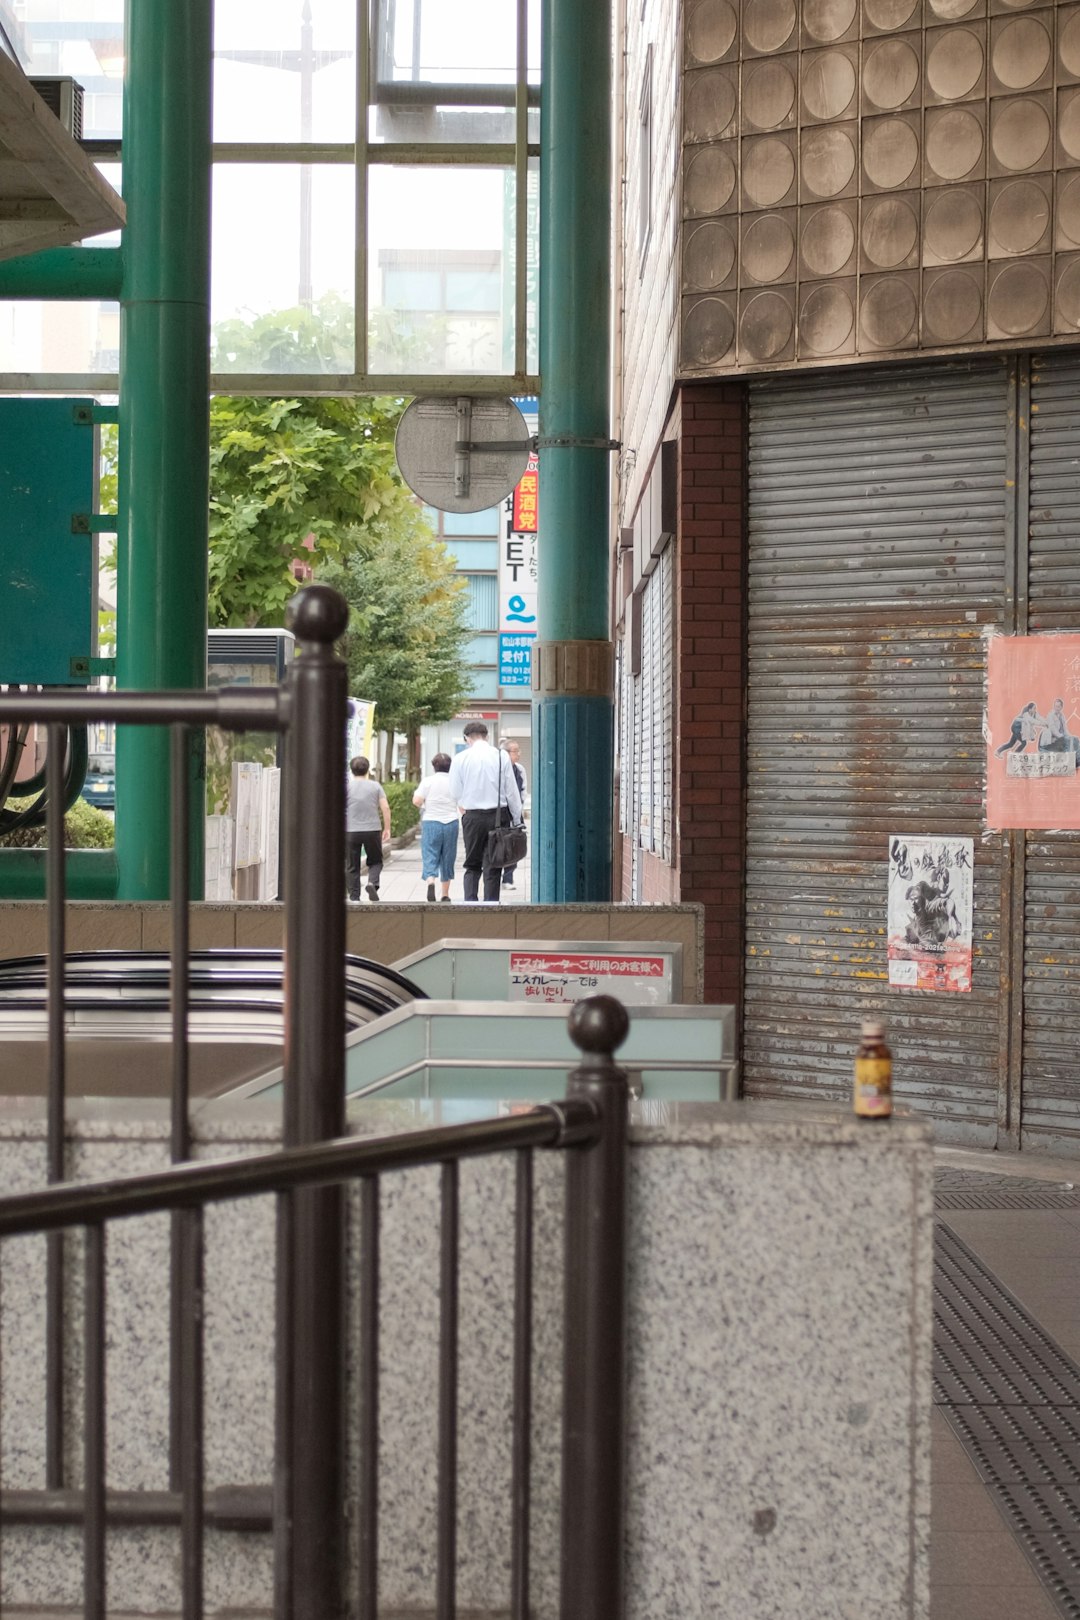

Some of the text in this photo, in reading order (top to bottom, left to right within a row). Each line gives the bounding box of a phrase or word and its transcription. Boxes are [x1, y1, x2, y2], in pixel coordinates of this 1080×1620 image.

[519, 475, 536, 529] 民酒党
[512, 957, 662, 973] エスカレーターご利用のお客様へ
[511, 974, 599, 987] エスカレーターでは
